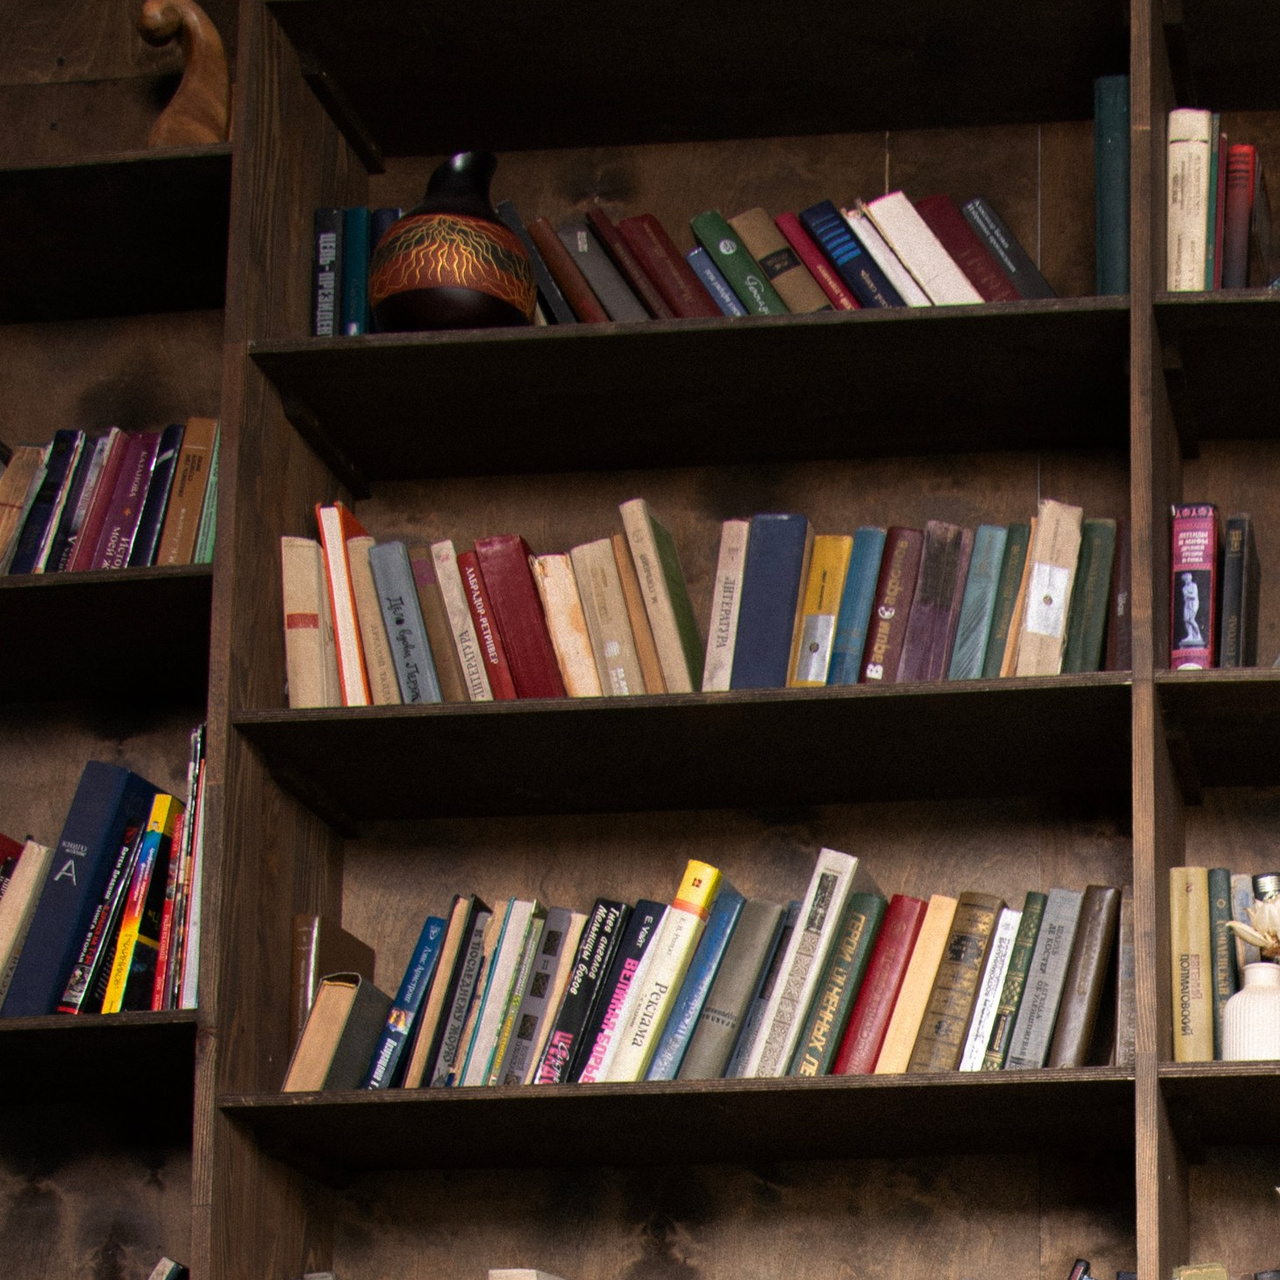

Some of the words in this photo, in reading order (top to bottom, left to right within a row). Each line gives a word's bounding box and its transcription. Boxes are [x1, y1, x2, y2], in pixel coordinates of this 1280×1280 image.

[712, 577, 737, 649] ЛИТЕРАТУРА
[456, 630, 486, 699] ЛИТЕРАТУРА
[580, 905, 610, 961] Мельницы
[601, 907, 619, 934] Гнев
[836, 912, 866, 961] ГЕРОИ
[567, 961, 590, 996] богов
[585, 935, 611, 979] ангелов
[1187, 953, 1203, 1000] ЕВГЕНИЙ
[599, 956, 640, 1032] ВЕЛИКАЯ
[631, 982, 667, 1046] Реклама
[1175, 953, 1194, 1035] ДОЛМАТОВСКИЙ
